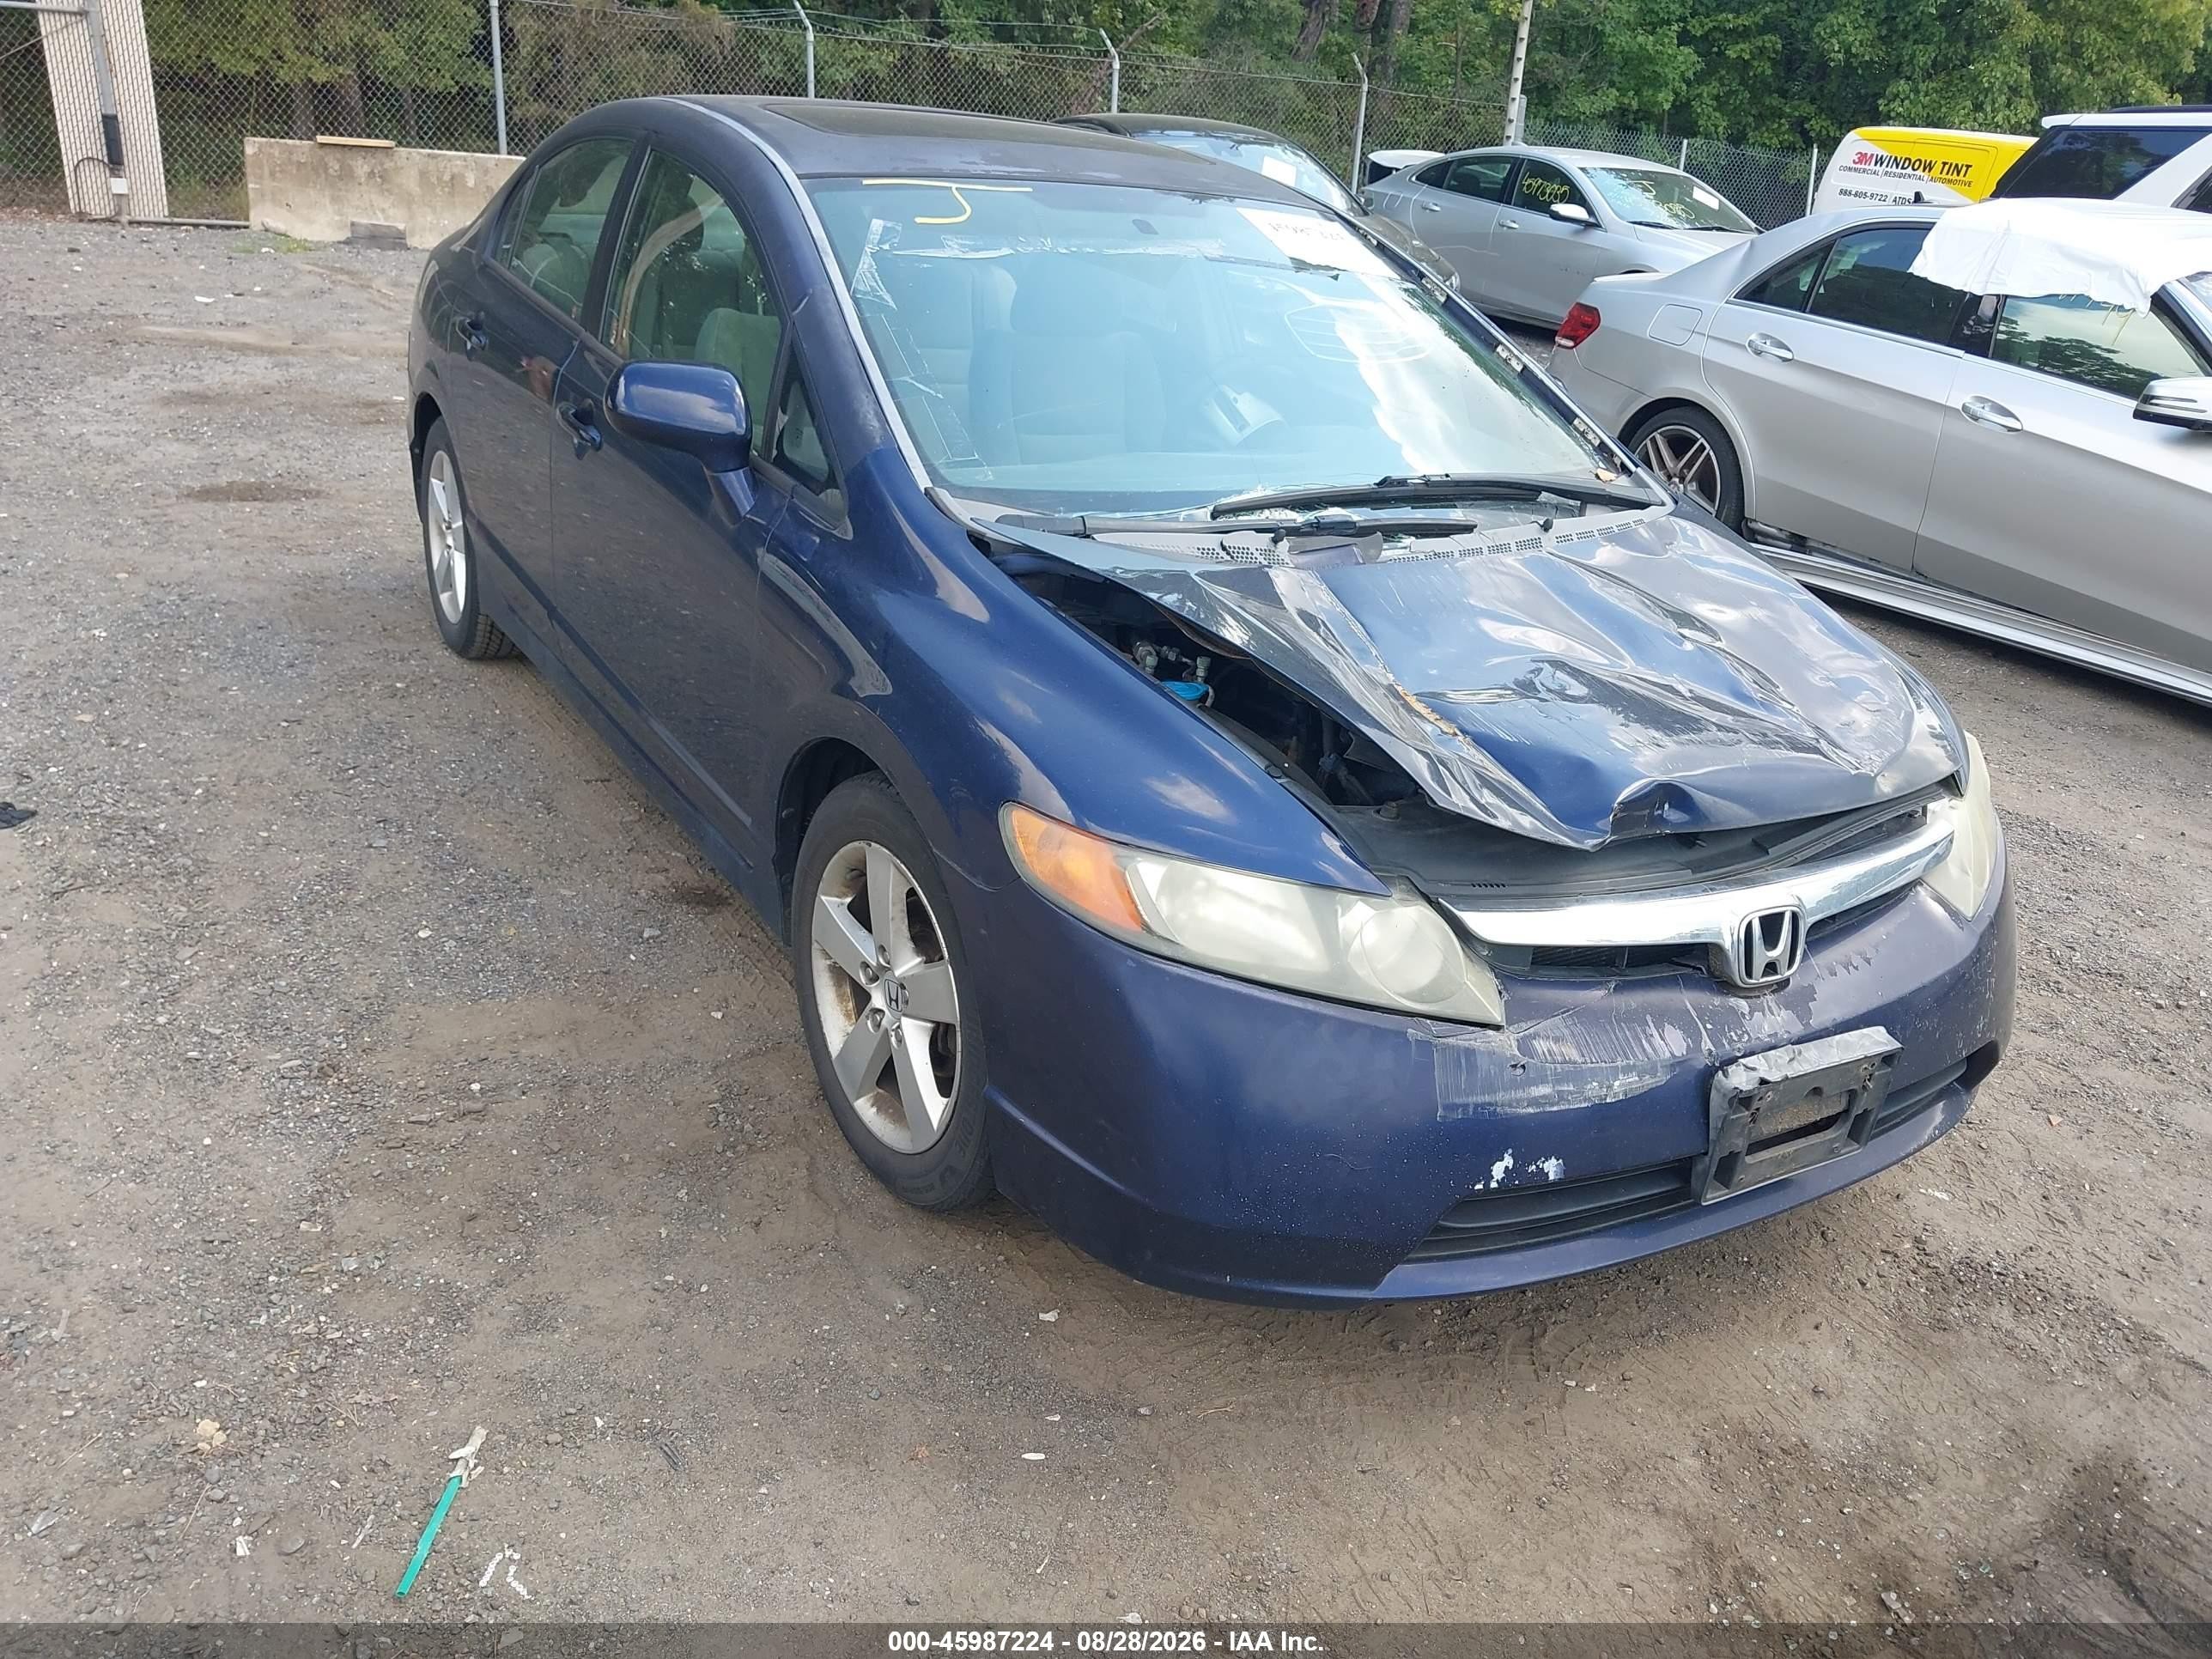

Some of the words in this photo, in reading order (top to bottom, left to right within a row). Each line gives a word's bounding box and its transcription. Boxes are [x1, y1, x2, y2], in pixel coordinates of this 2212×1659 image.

[1838, 165, 1881, 177] COMMERCIAL
[1883, 170, 1925, 182] RESIDENTIAL
[1929, 176, 1973, 188] AUTOMOTIVE
[1852, 151, 1875, 167] 3M
[1874, 154, 1937, 173] WINDOW
[1939, 161, 1973, 178] TINT
